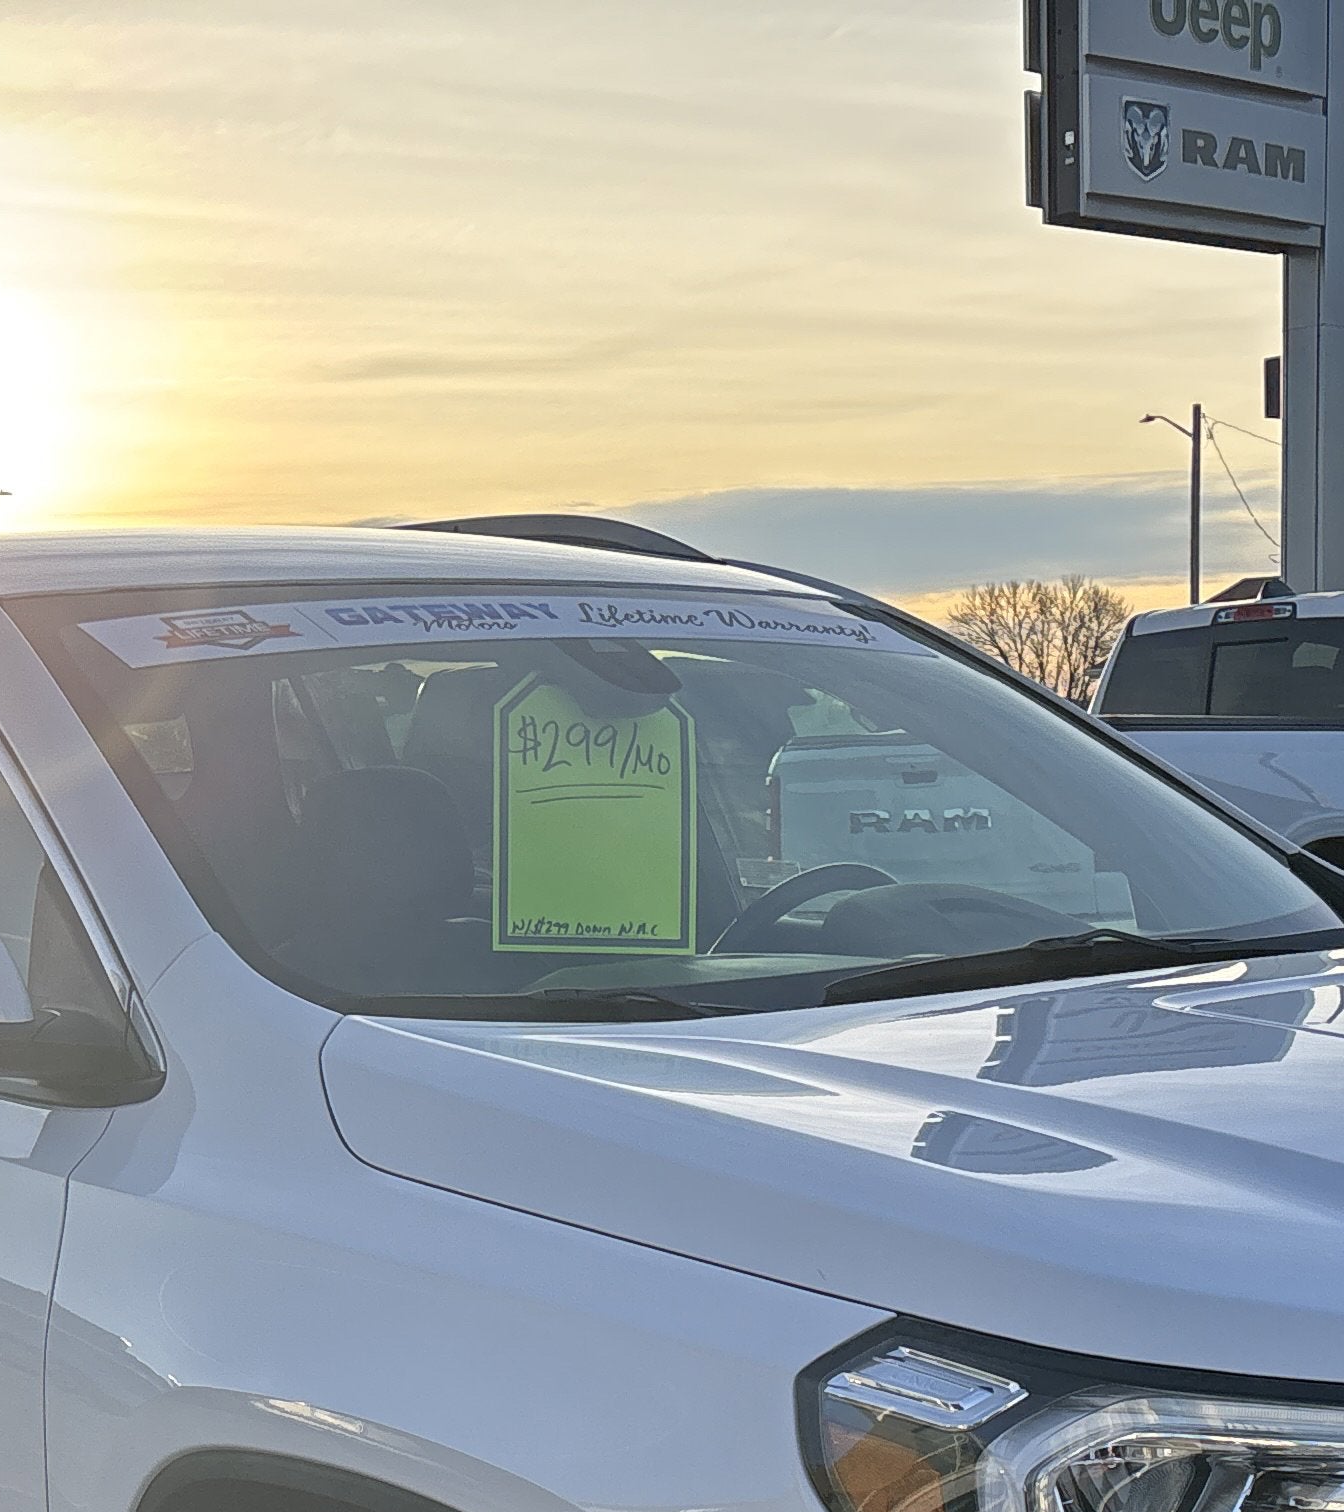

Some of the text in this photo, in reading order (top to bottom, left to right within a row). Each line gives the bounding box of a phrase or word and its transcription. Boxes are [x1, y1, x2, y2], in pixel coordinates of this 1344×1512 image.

[1149, 0, 1282, 71] Jeep
[1182, 128, 1306, 183] RAM
[324, 602, 878, 643] GATEWAY Lifetime Warranty!
[413, 617, 519, 633] Motors
[849, 807, 992, 834] RAM
